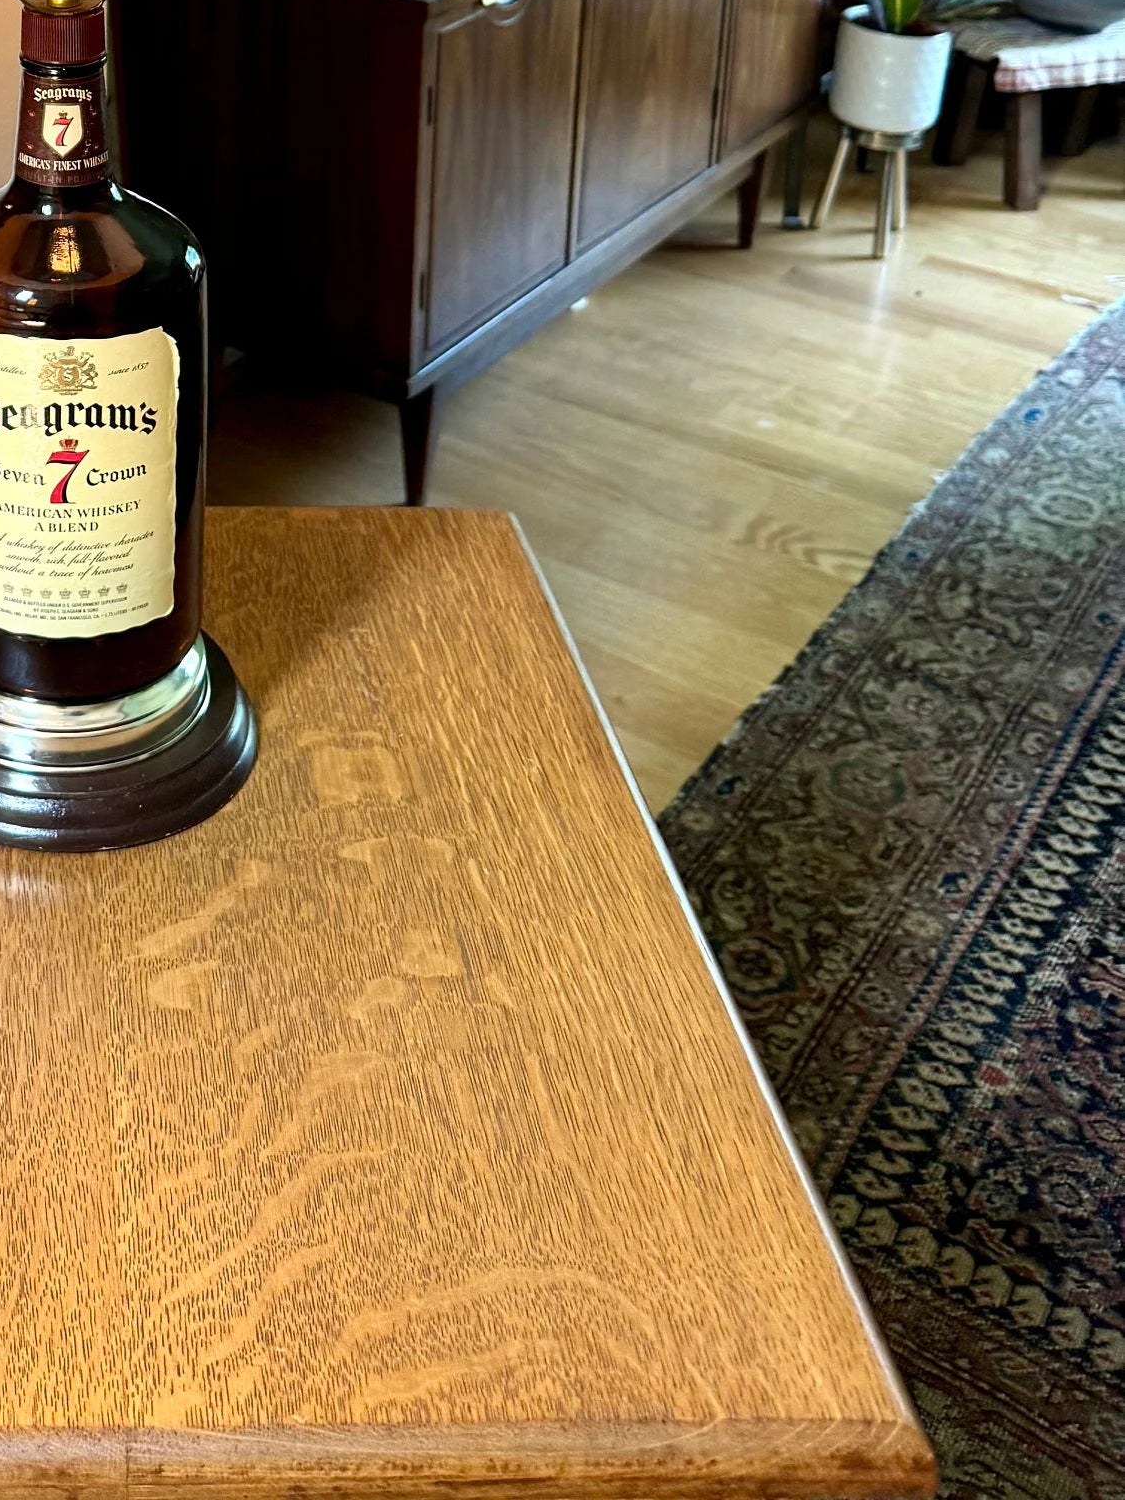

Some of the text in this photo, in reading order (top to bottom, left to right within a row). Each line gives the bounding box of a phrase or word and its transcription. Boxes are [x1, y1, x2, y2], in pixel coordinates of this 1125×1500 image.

[33, 86, 93, 102] Seagram's
[53, 116, 74, 147] 7
[18, 152, 51, 170] AMERICA'S
[53, 160, 82, 171] FINEST
[45, 449, 90, 504] 7
[86, 463, 147, 487] Crown
[77, 499, 142, 517] WHISKEY
[34, 521, 99, 533] A BLEND
[8, 537, 46, 553] whiskey
[48, 541, 64, 554] of
[62, 540, 111, 551] distinctive
[115, 531, 154, 546] character
[0, 563, 36, 575] without
[78, 565, 94, 580] of
